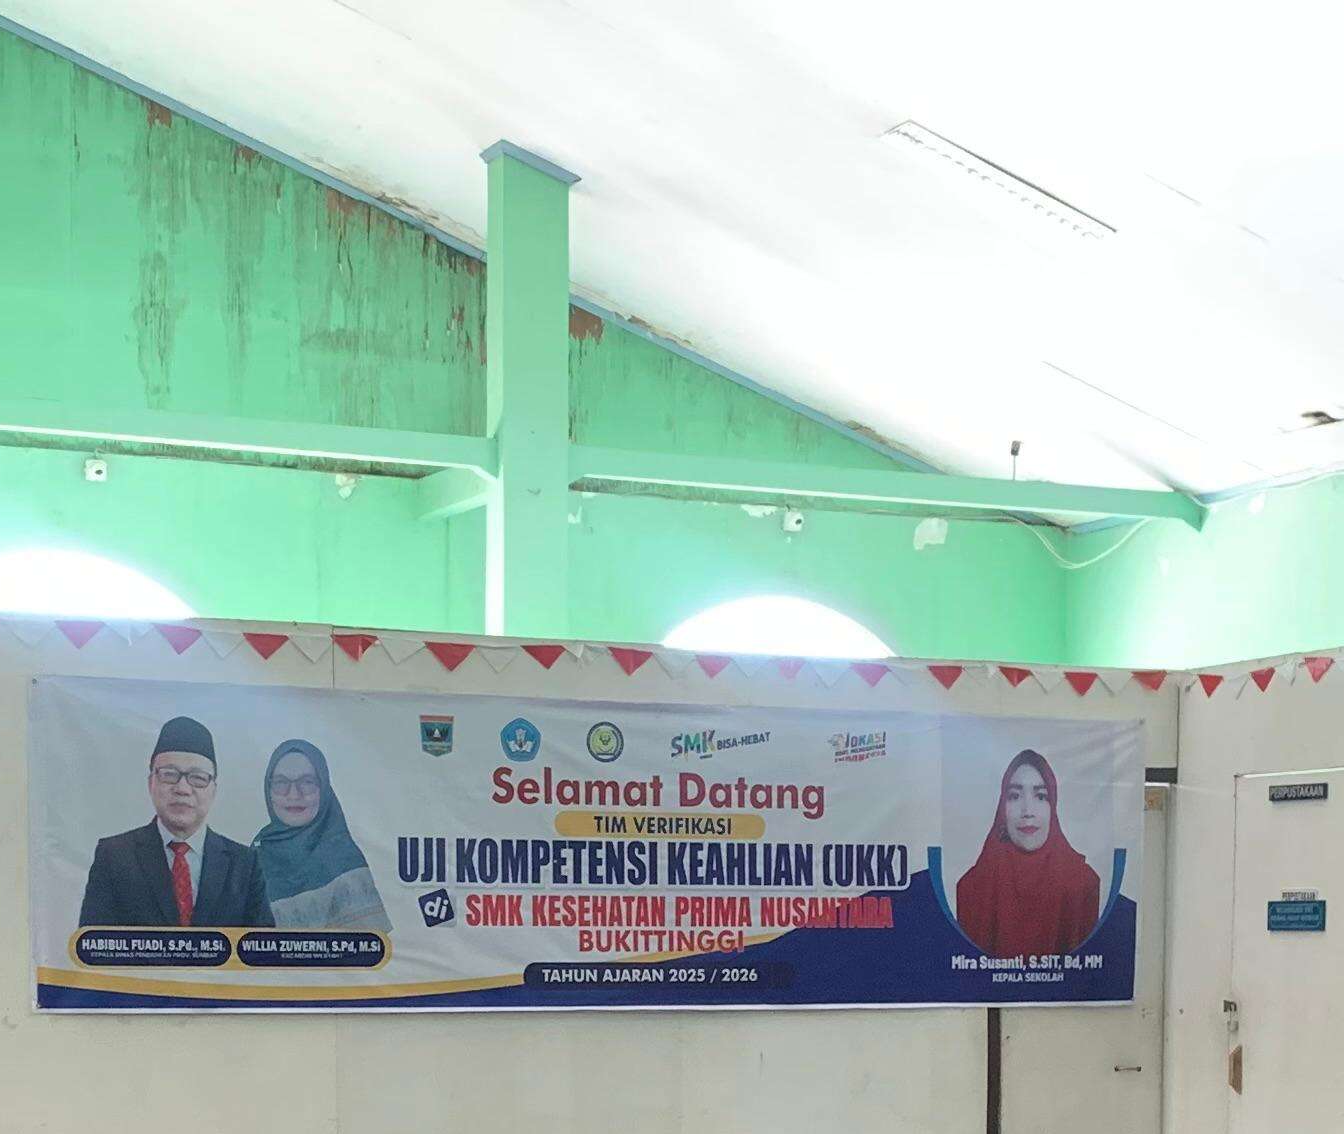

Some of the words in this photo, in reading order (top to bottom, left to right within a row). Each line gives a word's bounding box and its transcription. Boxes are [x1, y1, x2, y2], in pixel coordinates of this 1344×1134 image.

[671, 729, 716, 758] SMK
[717, 731, 771, 751] BISA-HEBAT
[492, 766, 663, 806] Selamat
[679, 772, 825, 820] Datang
[594, 815, 626, 833] TIM
[633, 816, 732, 835] VERIFIKASI
[397, 837, 446, 882] UJI
[456, 838, 658, 885] KOMPETENSI
[667, 842, 814, 886] KEAHLIAN
[822, 844, 908, 887] (UKK)
[424, 893, 449, 919] di
[466, 894, 523, 926] SMK
[532, 895, 666, 927] KESEHATAN
[675, 896, 752, 927] PRIMA
[760, 896, 893, 928] NUSANTARA
[81, 938, 129, 951] HABIBUL
[131, 939, 166, 952] FUADI,
[242, 940, 277, 951] WILLIA
[279, 940, 329, 953] ZUWERNI,
[359, 940, 381, 952] M.Si
[579, 930, 744, 953] BUKITTINGGI
[951, 954, 977, 969] Mira
[979, 954, 1026, 970] Susanti,
[1064, 955, 1082, 971] Bd,
[1084, 955, 1103, 969] MM
[542, 969, 597, 982] TAHUN
[602, 969, 664, 982] AJARAN
[669, 969, 706, 982] 2025
[722, 969, 758, 982] 2026
[992, 972, 1023, 982] KEPALA
[1025, 972, 1064, 982] SEKOLAH
